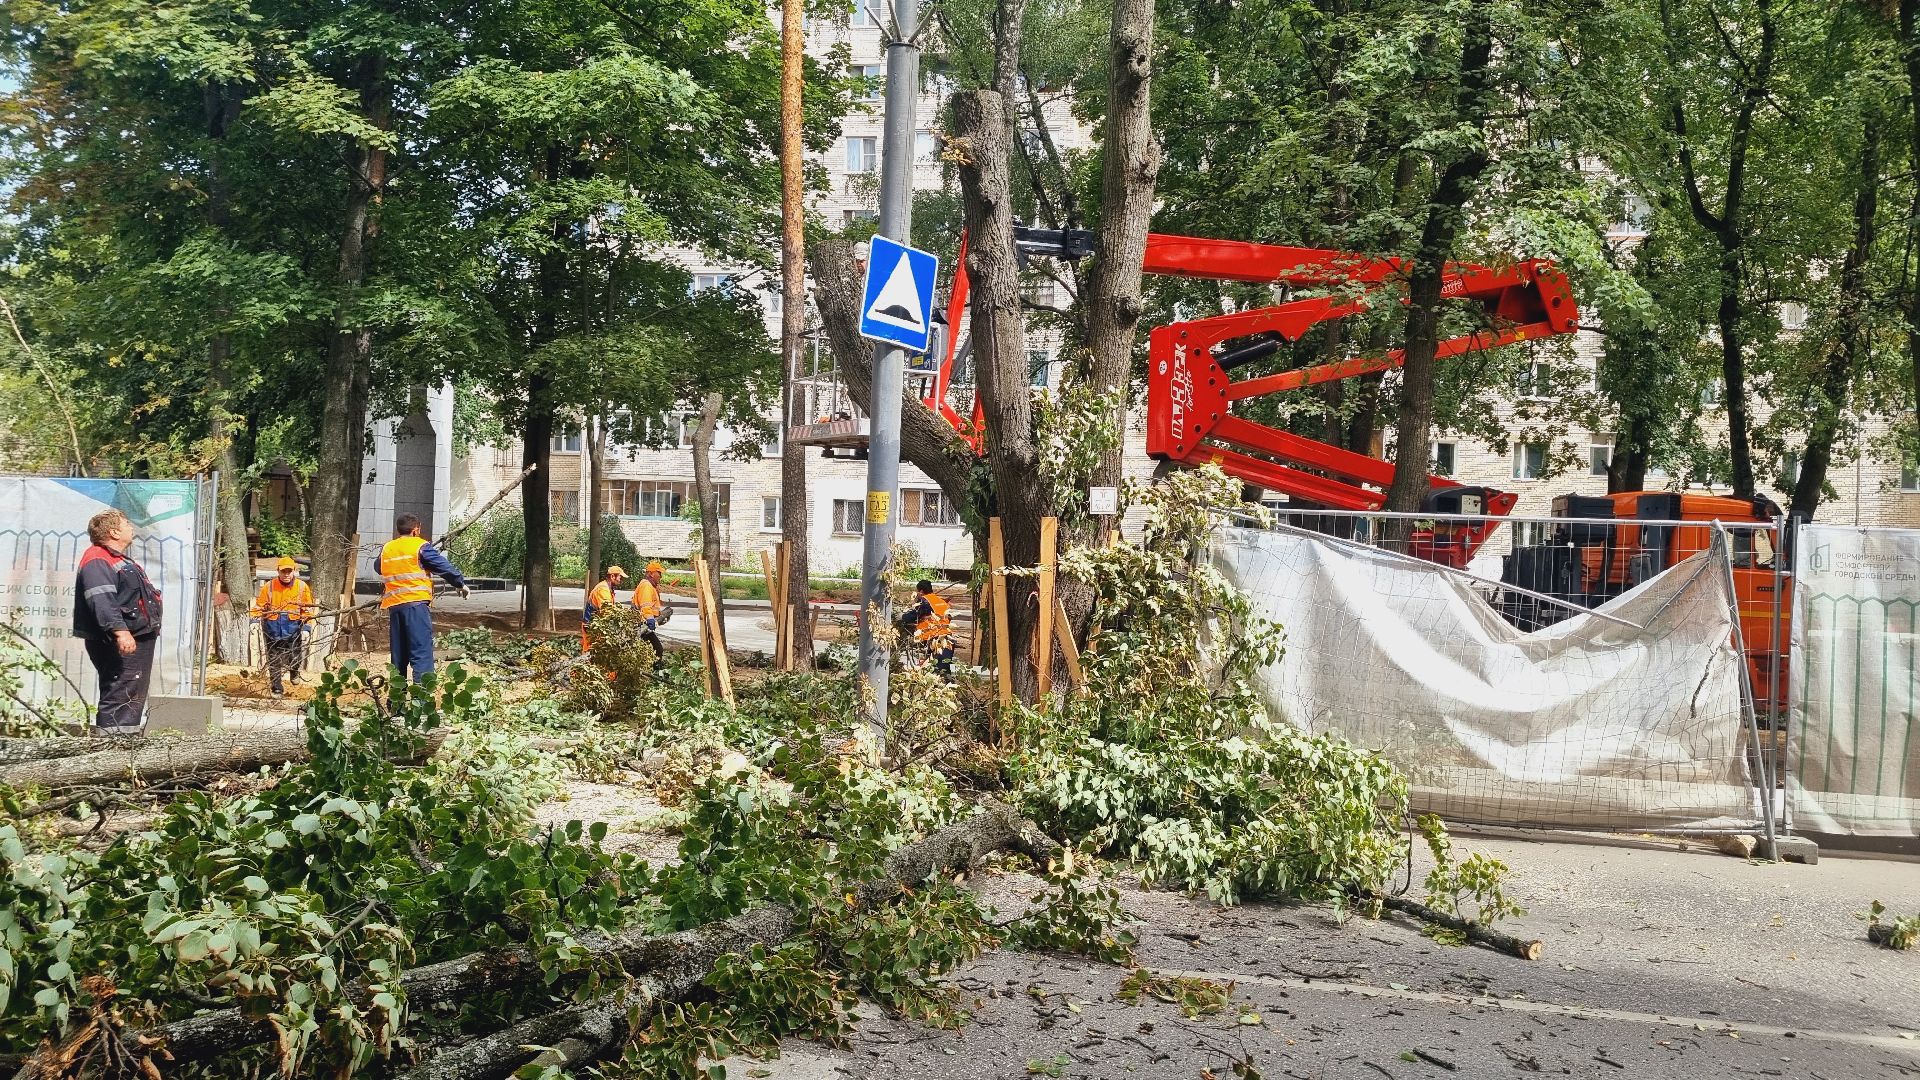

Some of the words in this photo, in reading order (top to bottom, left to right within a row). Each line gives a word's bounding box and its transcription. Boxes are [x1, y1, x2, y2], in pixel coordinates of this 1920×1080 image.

[1835, 552, 1904, 562] ФОРМИРОВАНИЕ
[1834, 570, 1883, 580] ГОРОДСКОЙ
[1885, 573, 1916, 581] СРЕДЫ
[26, 584, 58, 596] свои
[39, 628, 62, 640] для
